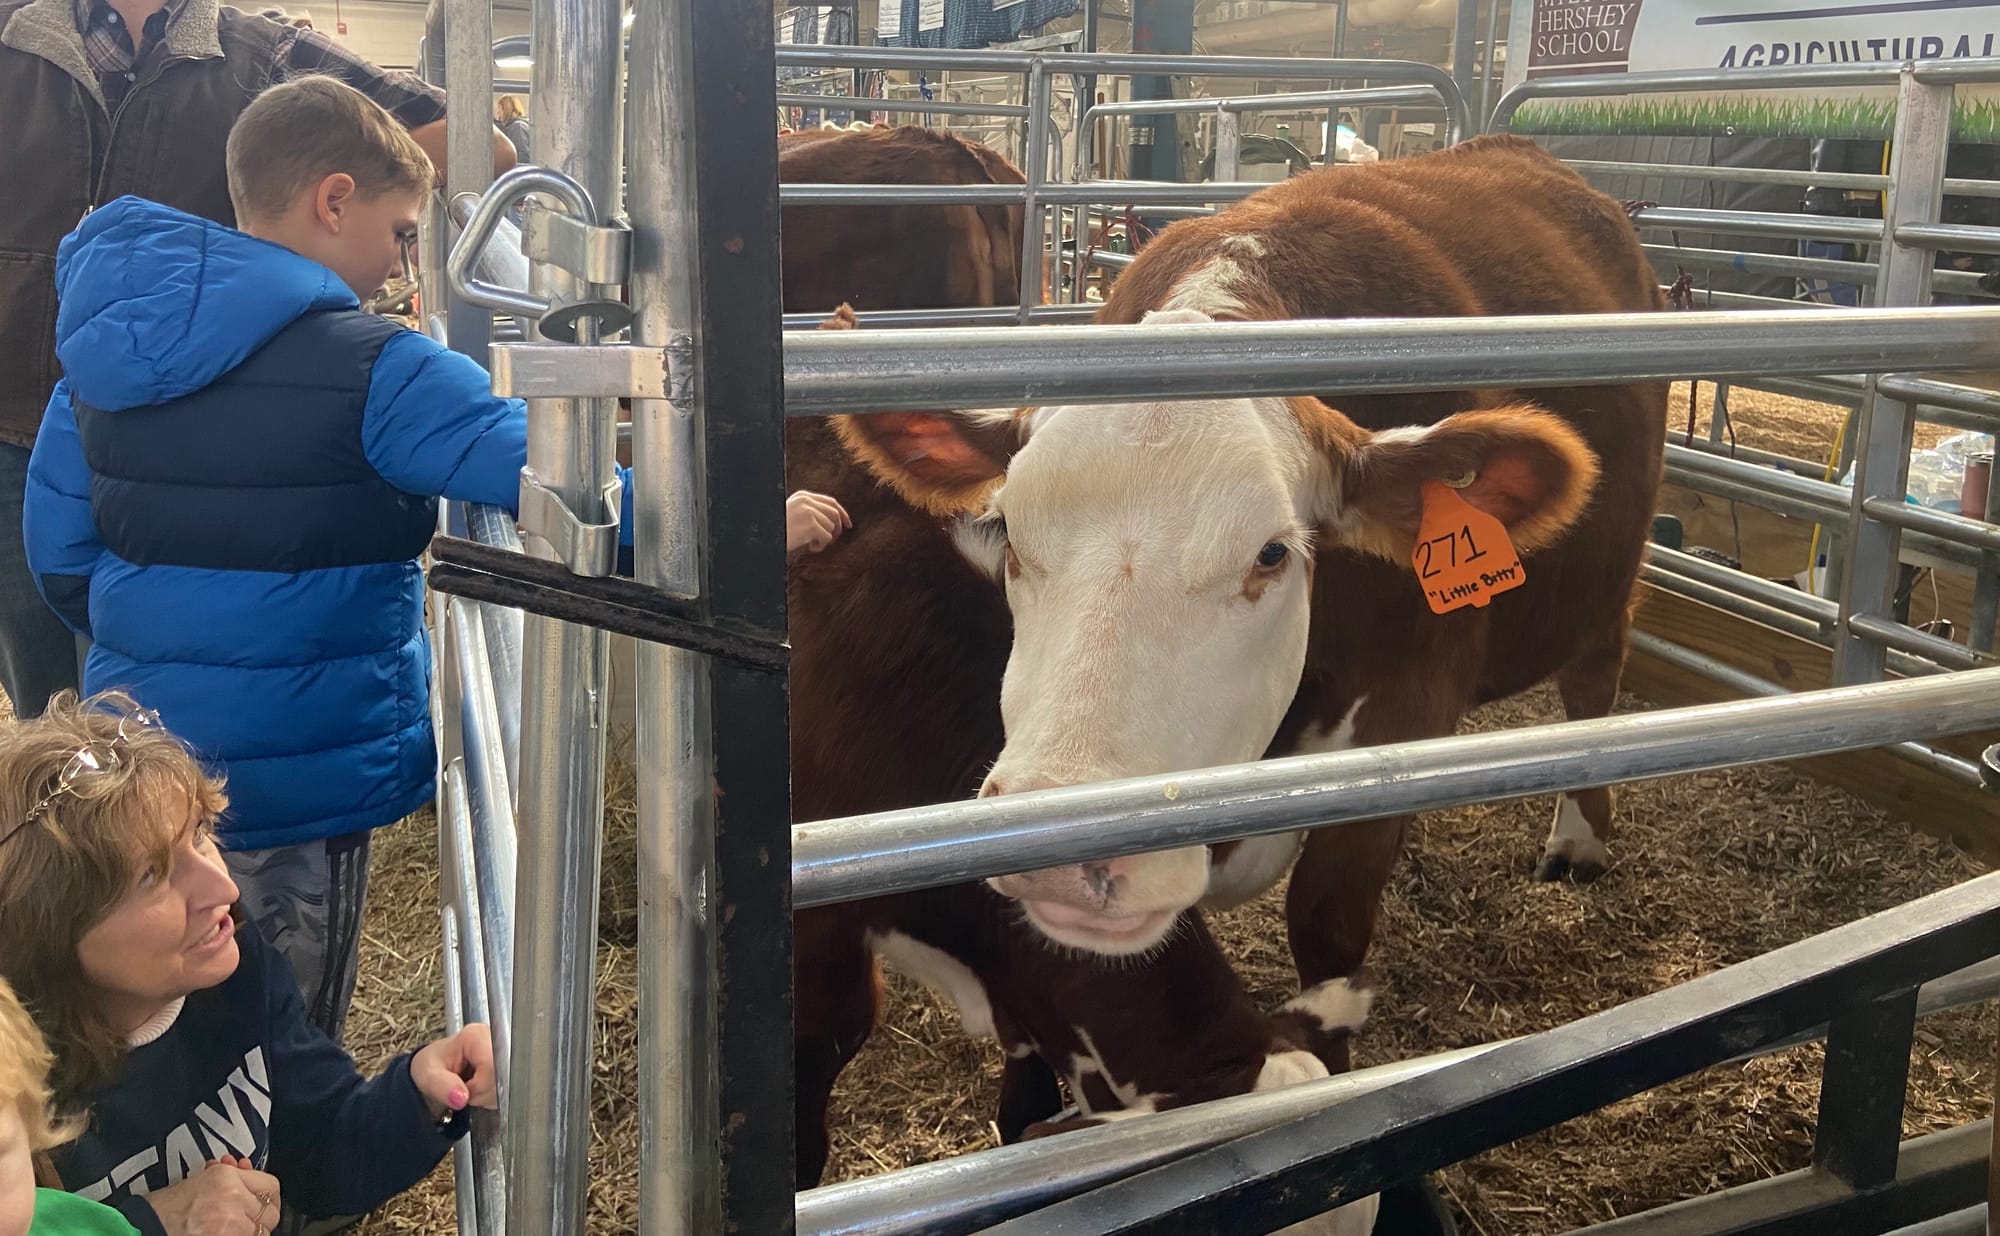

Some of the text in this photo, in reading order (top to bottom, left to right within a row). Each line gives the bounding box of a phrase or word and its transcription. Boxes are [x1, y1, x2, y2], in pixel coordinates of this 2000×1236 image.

[1538, 3, 1636, 33] HERSHEY
[1536, 29, 1625, 57] SCHOOL
[1415, 525, 1488, 579] 271
